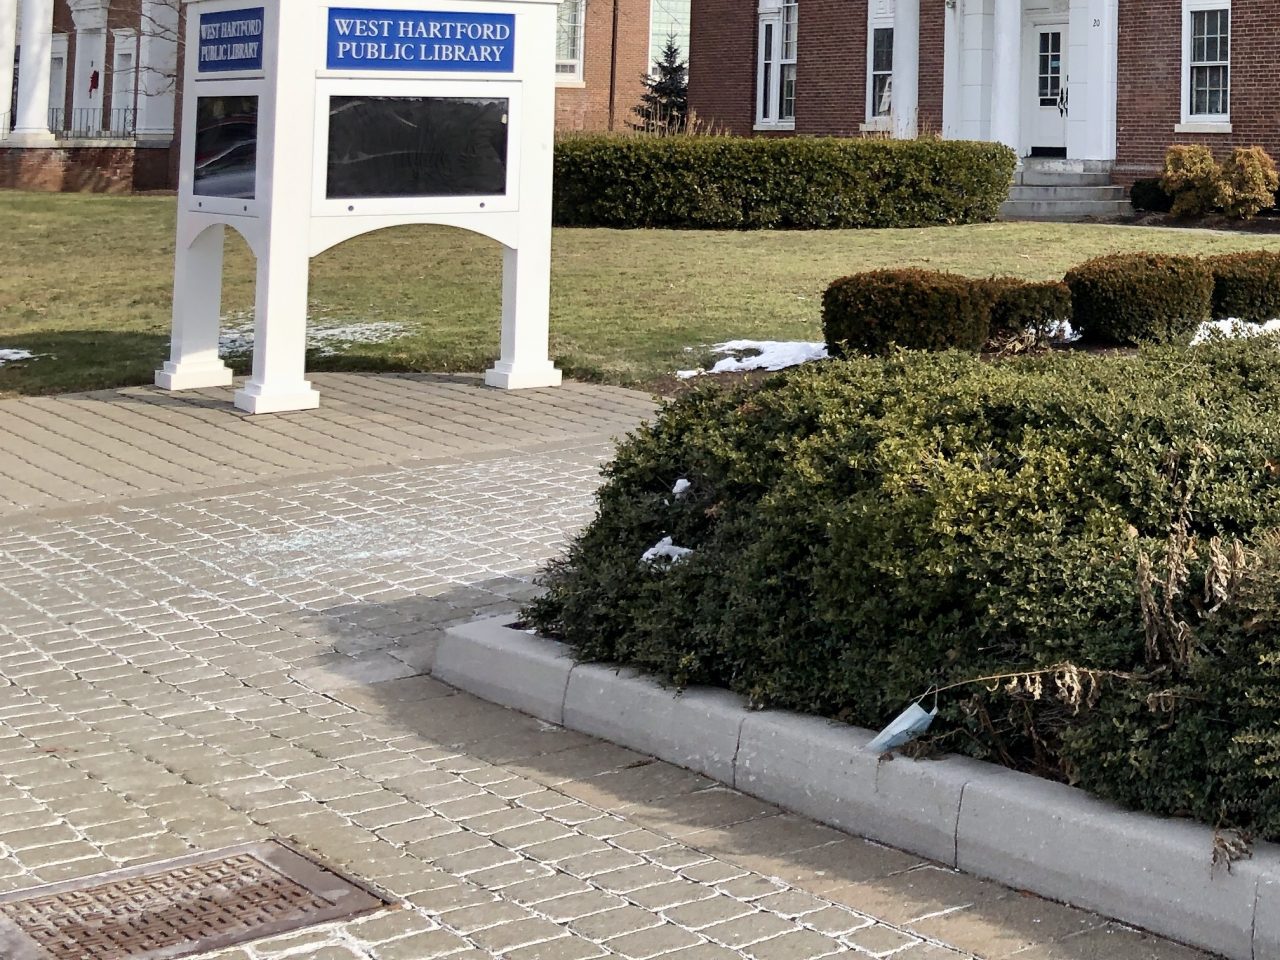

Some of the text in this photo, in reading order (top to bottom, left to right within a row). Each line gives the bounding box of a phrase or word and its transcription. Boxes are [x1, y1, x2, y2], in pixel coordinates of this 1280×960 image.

[201, 19, 262, 40] WEST HARTFORD
[334, 18, 510, 40] WEST HARTFORD
[1092, 18, 1101, 28] 20
[201, 41, 259, 62] PUBLIC LIBRARY
[337, 41, 505, 62] PUBLIC LIBRARY
